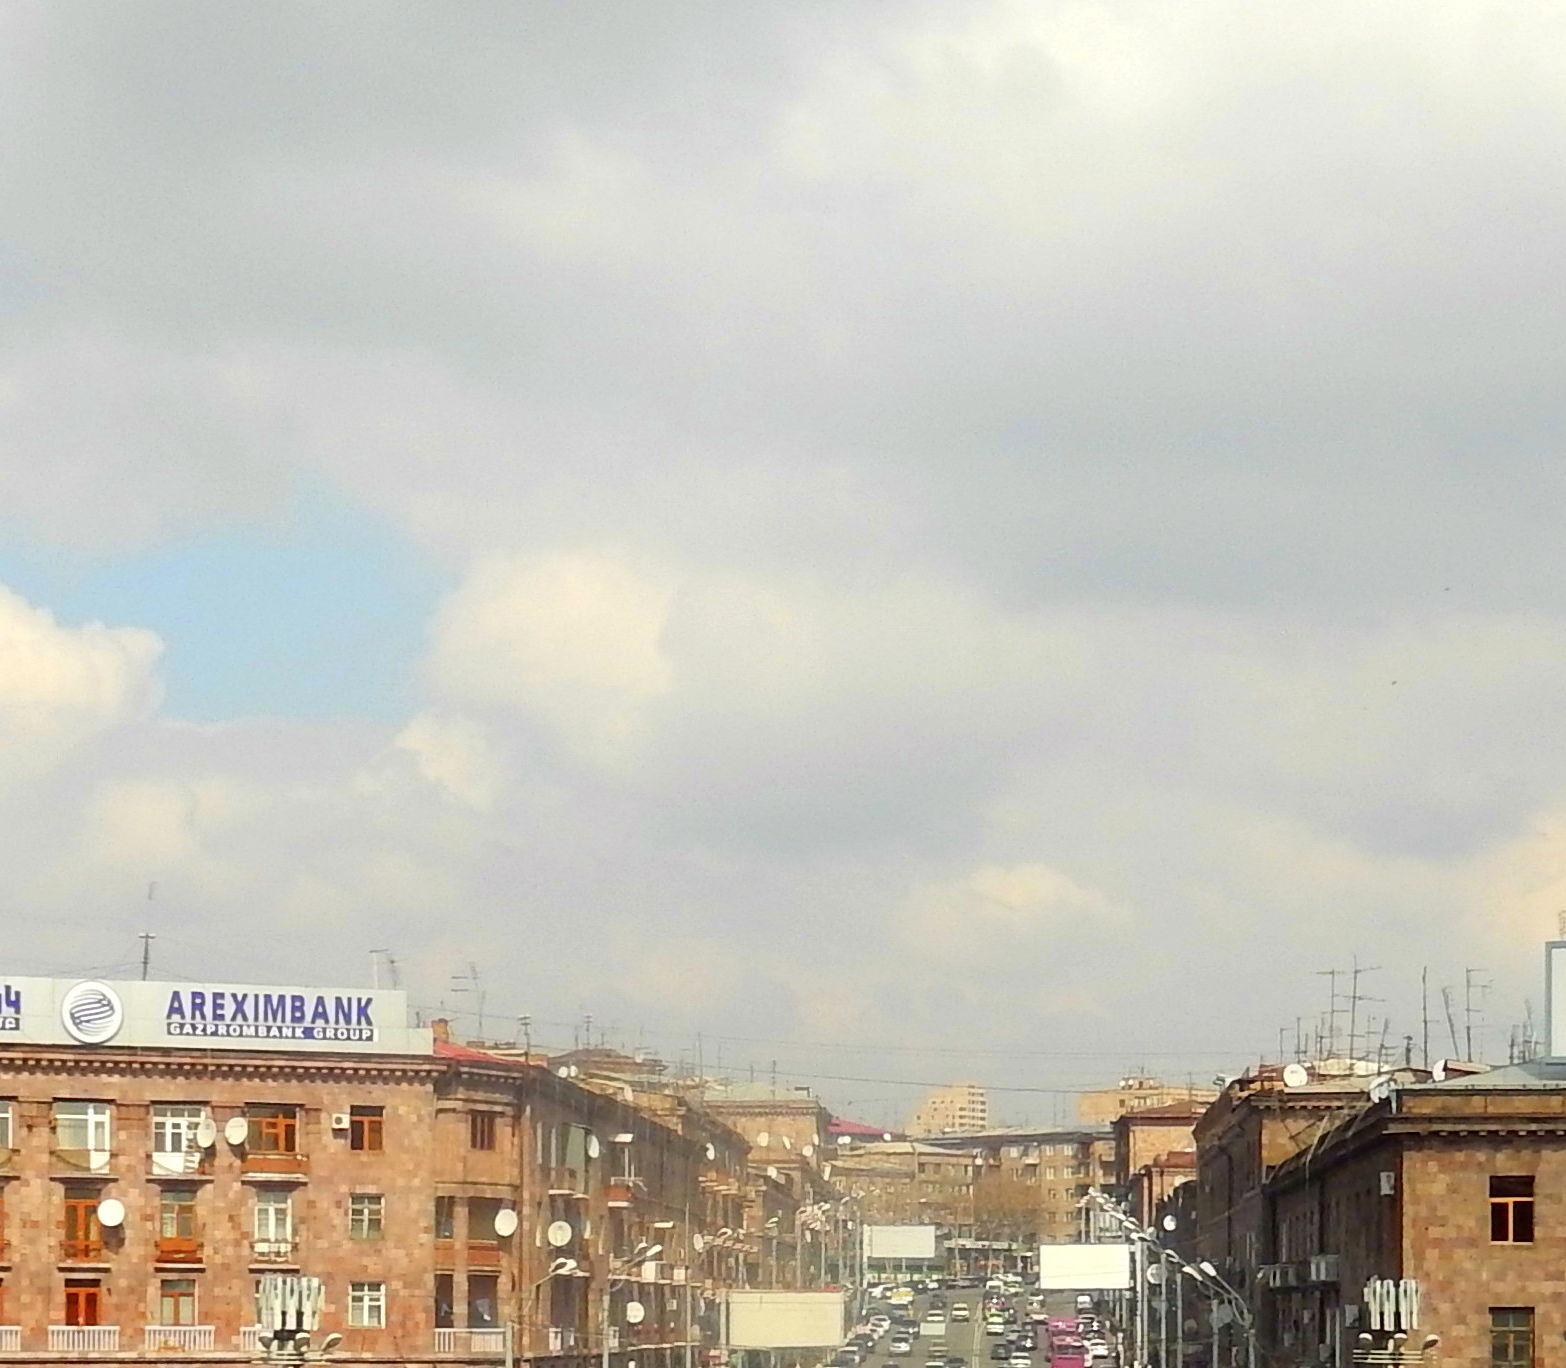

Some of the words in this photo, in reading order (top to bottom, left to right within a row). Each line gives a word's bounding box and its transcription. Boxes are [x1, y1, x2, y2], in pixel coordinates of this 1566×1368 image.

[166, 990, 374, 1027] AREXIMBANK
[169, 1023, 305, 1039] GAZPROMBANK
[313, 1027, 372, 1040] GROUP
